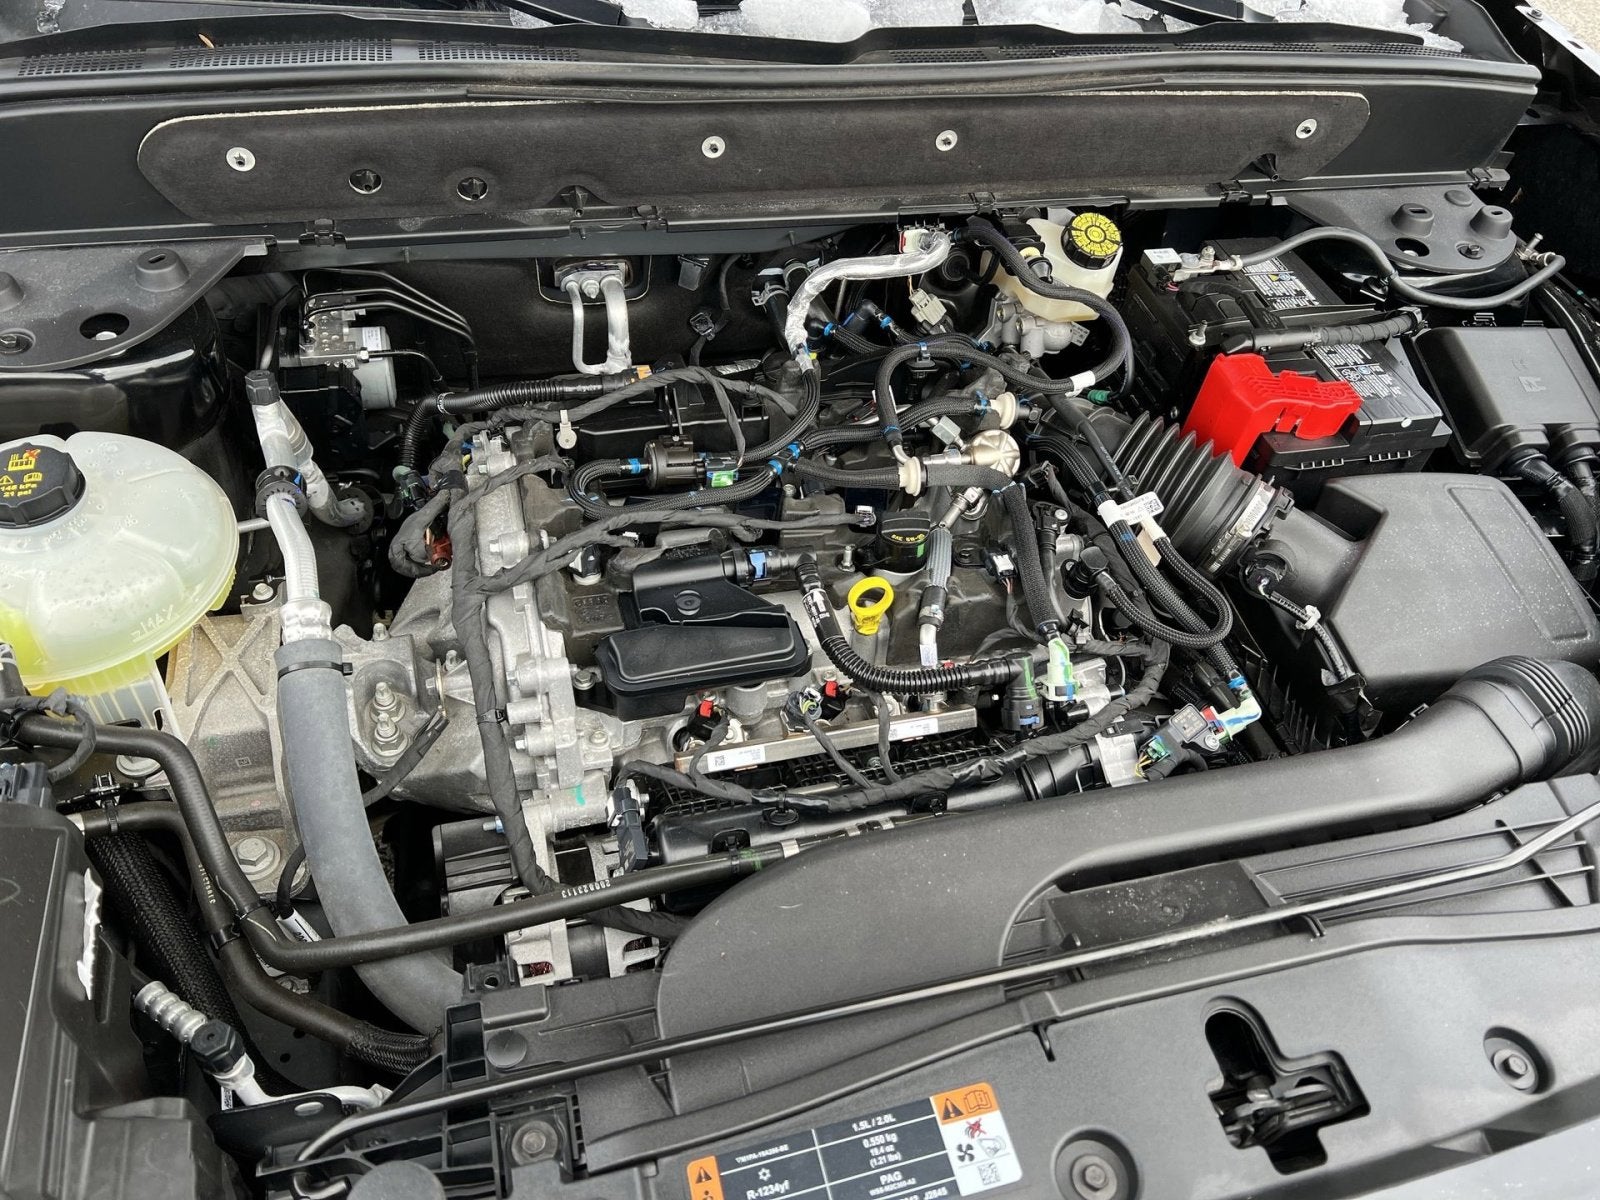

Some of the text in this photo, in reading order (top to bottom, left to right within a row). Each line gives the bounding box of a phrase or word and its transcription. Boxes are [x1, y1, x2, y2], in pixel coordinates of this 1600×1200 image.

[852, 1120, 871, 1133] 1.5L
[877, 1114, 896, 1126] 2.0L
[862, 1132, 898, 1148] 0.550 kg
[870, 1146, 884, 1156] 19.4
[870, 1151, 901, 1168] (1.21 lbs)
[880, 1172, 903, 1185] PAG
[746, 1179, 790, 1200] R-1234yf
